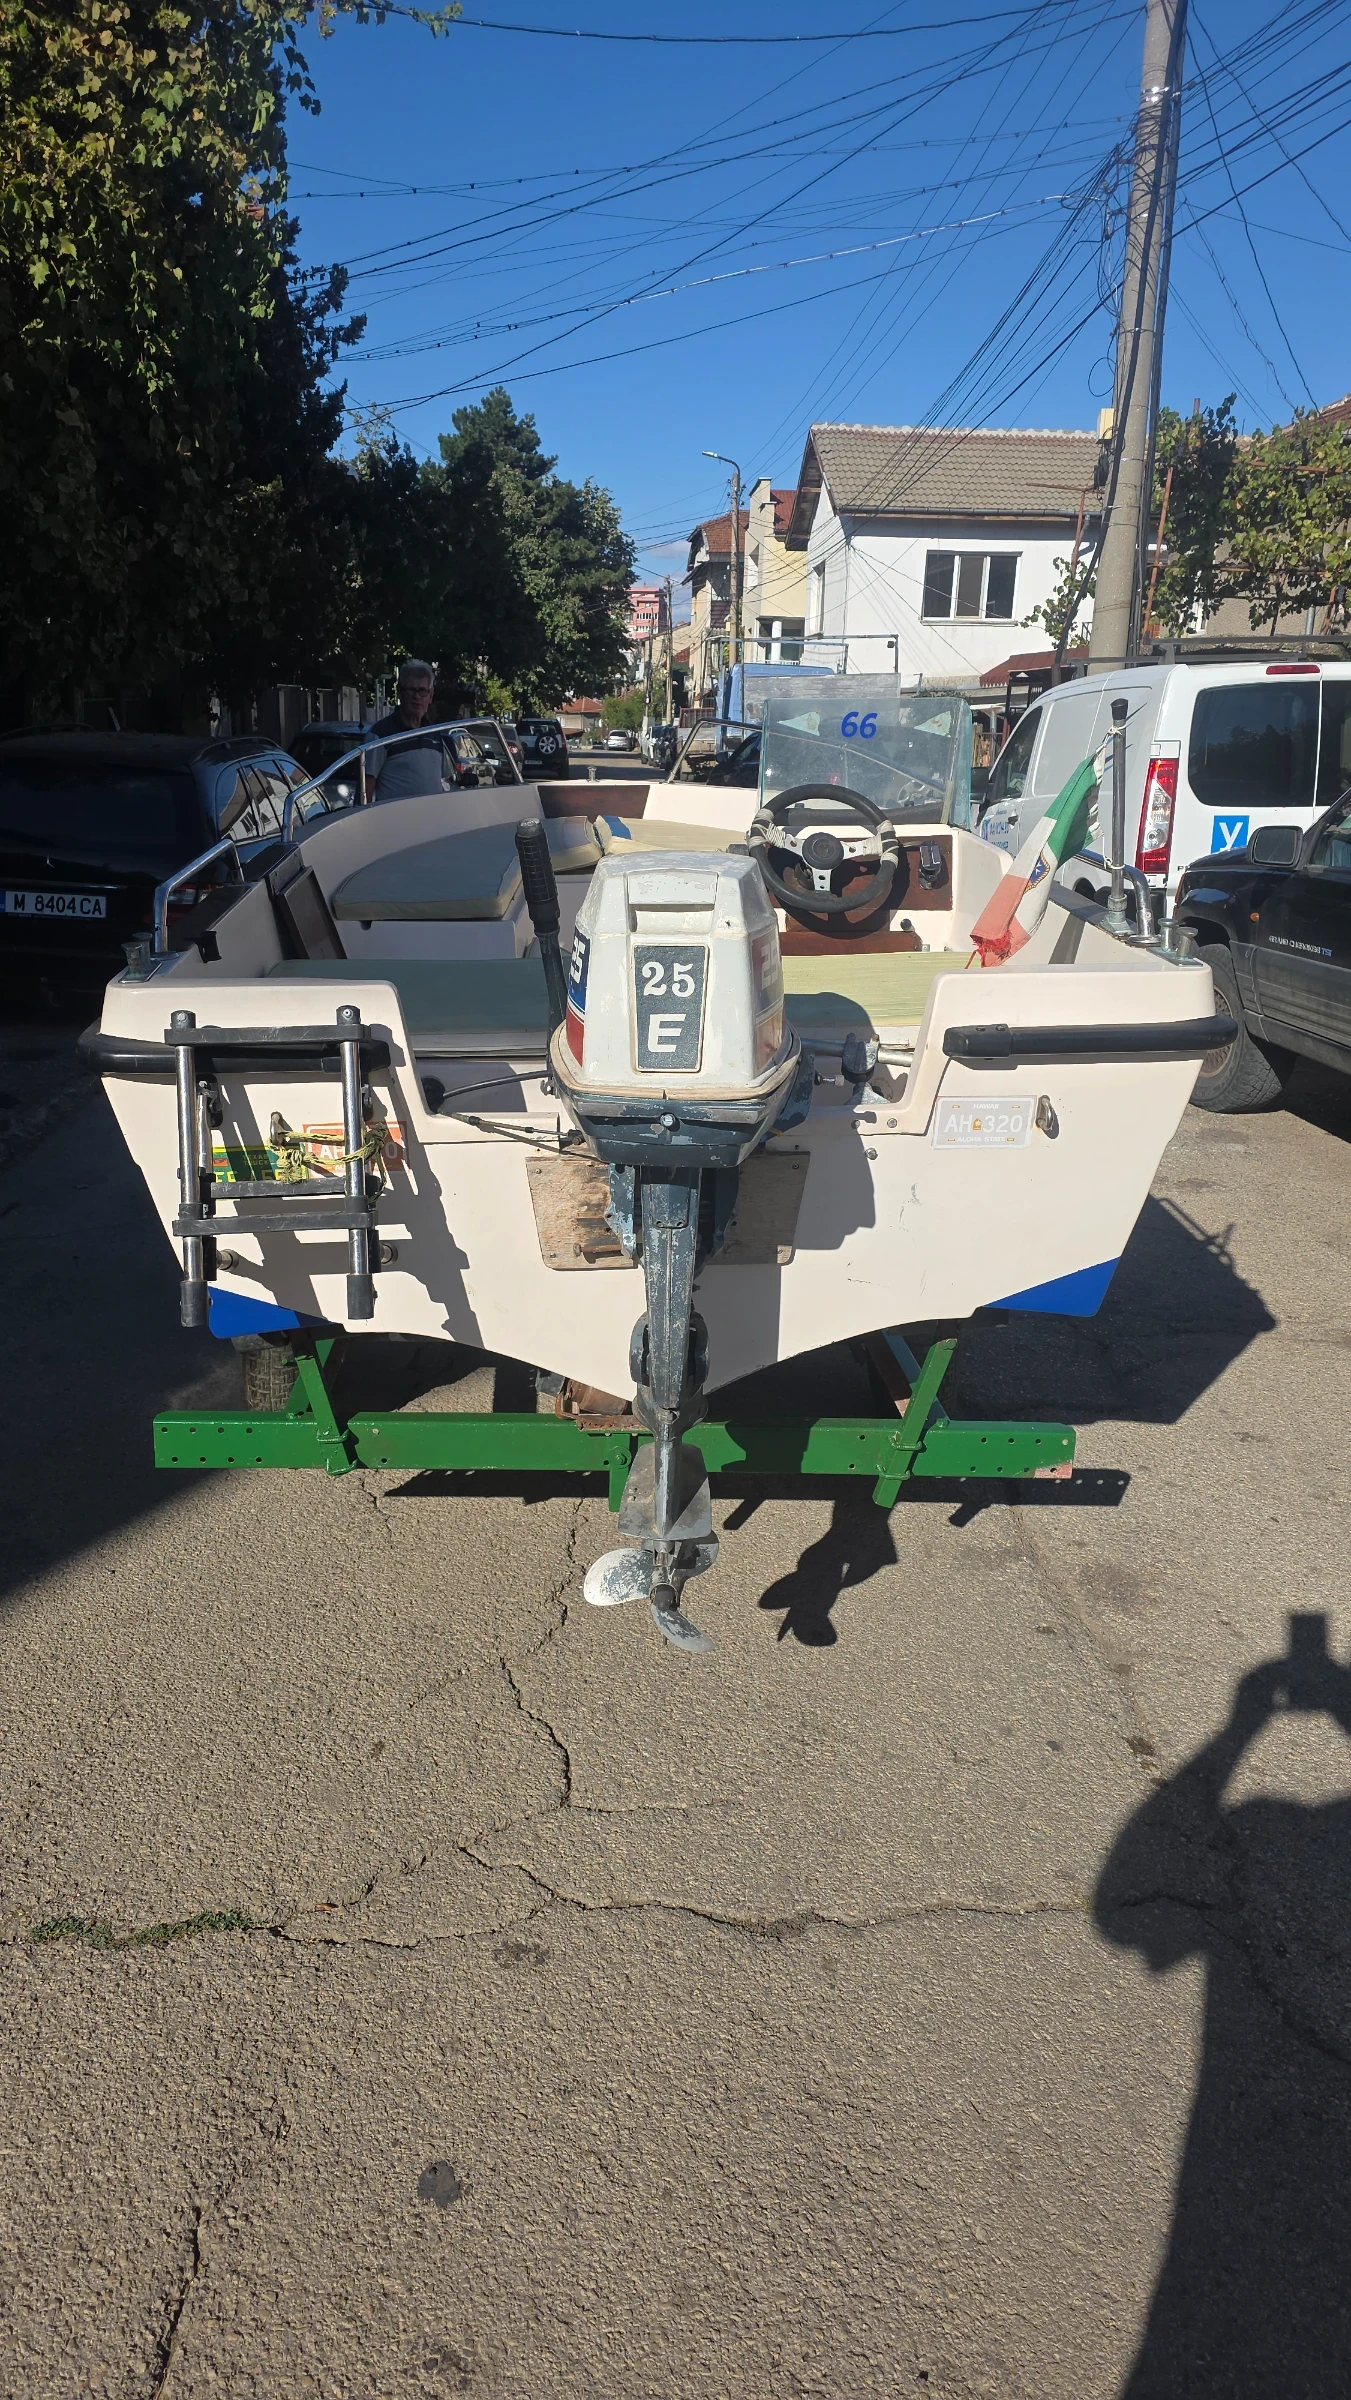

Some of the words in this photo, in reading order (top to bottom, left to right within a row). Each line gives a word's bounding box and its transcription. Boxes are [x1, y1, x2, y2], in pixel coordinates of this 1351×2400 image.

[841, 711, 879, 739] 66
[13, 893, 26, 911] M
[34, 894, 77, 914] 8404
[80, 897, 103, 916] CA
[641, 961, 696, 998] 25
[647, 1013, 687, 1053] E
[983, 1114, 1023, 1133] 320
